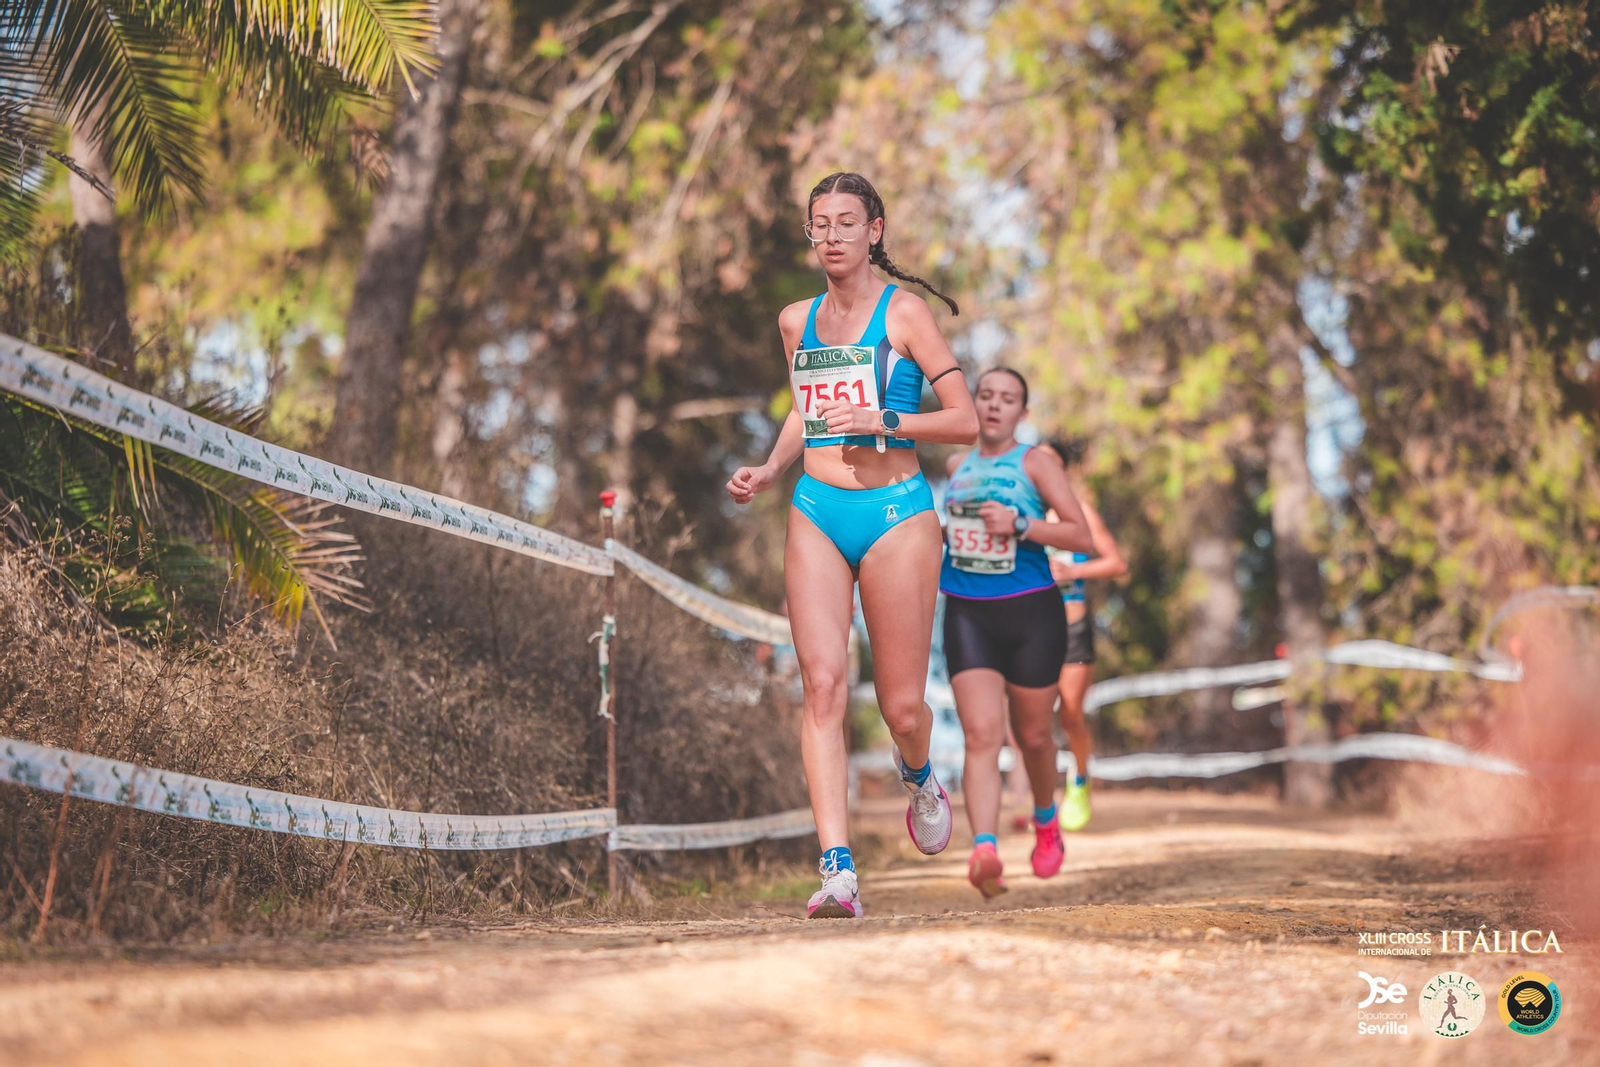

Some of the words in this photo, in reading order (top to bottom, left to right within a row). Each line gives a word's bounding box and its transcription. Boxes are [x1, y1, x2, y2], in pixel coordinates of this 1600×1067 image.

[811, 350, 848, 364] ITÁLICA
[799, 379, 871, 414] 7561
[953, 527, 1009, 555] 5533
